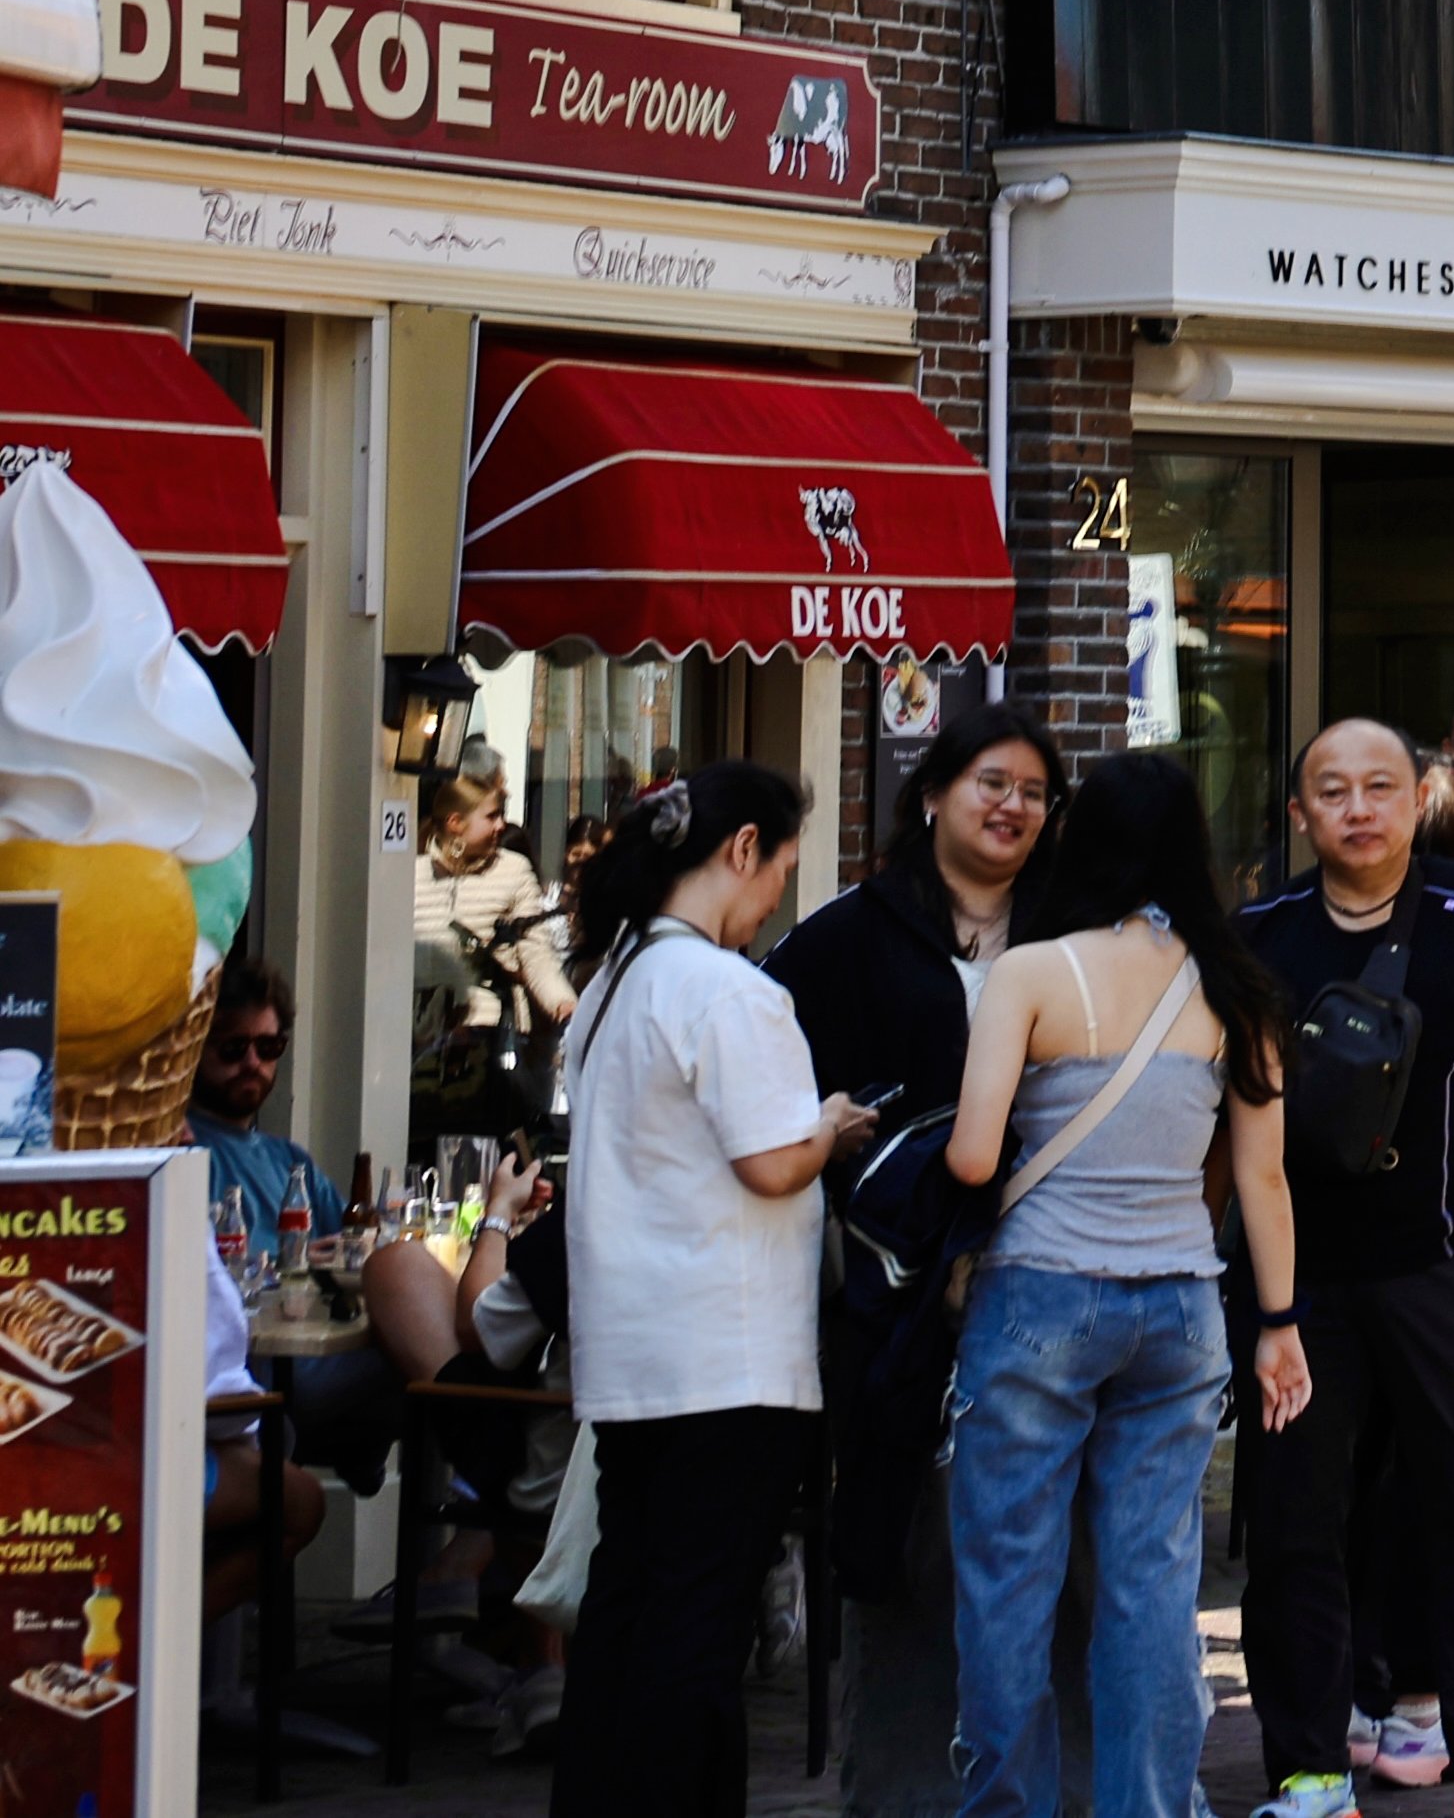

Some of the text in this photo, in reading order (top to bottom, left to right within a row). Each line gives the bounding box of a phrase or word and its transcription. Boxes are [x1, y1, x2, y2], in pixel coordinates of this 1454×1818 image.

[284, 0, 494, 128] KOE
[528, 46, 736, 142] Tea-room
[573, 226, 717, 291] Quickservice
[1070, 477, 1131, 552] 24
[791, 586, 906, 639] DE KOE
[383, 809, 405, 843] 26
